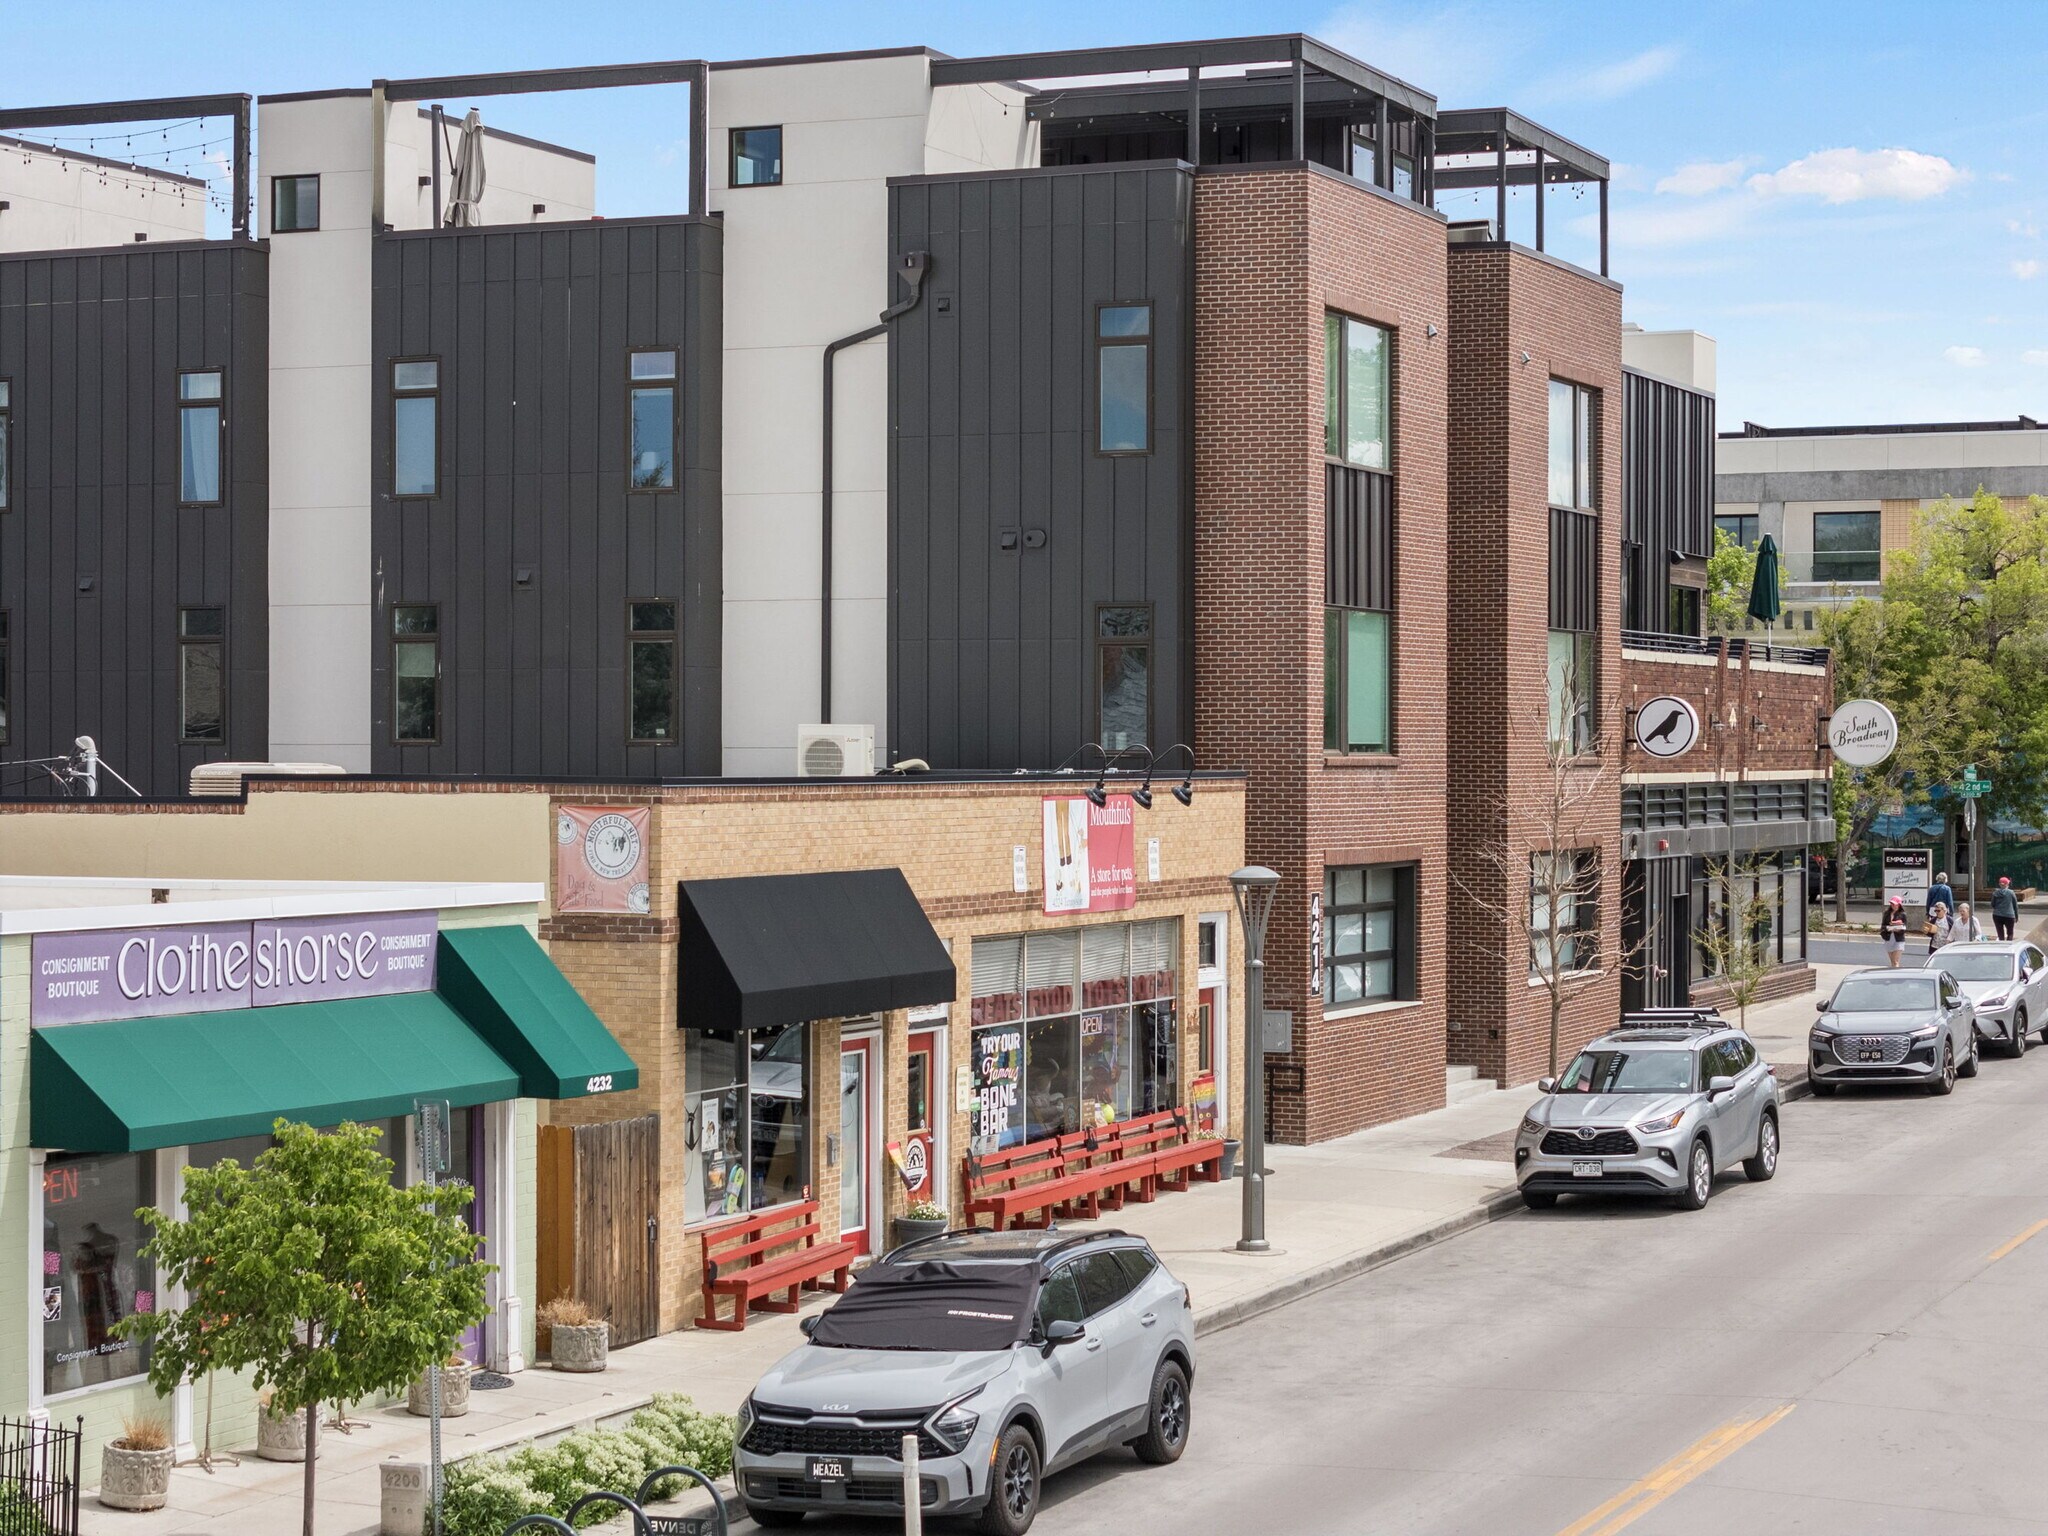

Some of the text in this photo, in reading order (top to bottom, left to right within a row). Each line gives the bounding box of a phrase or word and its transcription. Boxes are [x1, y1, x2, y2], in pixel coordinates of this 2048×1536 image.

[1845, 715, 1878, 734] South
[1833, 729, 1890, 748] Broadway
[1090, 801, 1132, 826] Mouthfuls
[587, 815, 638, 844] MOUTHFULS.NET
[1090, 864, 1133, 885] A store for pets
[380, 933, 432, 951] CONSIGNMENT
[1312, 896, 1320, 992] 4214
[42, 955, 111, 976] CONSIGNMENT
[117, 928, 379, 1001] Clotheshorse
[387, 955, 425, 971] BOUTIQUE
[48, 980, 100, 999] BOUTIQUE
[971, 992, 1023, 1026] REATS
[1027, 985, 1074, 1017] FOOD
[1082, 1016, 1102, 1034] OPEN
[981, 1033, 1020, 1055] TRY OUR
[982, 1056, 1019, 1085] Famous
[586, 1074, 613, 1093] 4232
[981, 1083, 1018, 1111] BONE
[981, 1107, 1008, 1136] BAR
[56, 1340, 130, 1363] Consignment Boutique
[385, 1472, 420, 1488] 4200
[812, 1462, 845, 1478] WEAZEL
